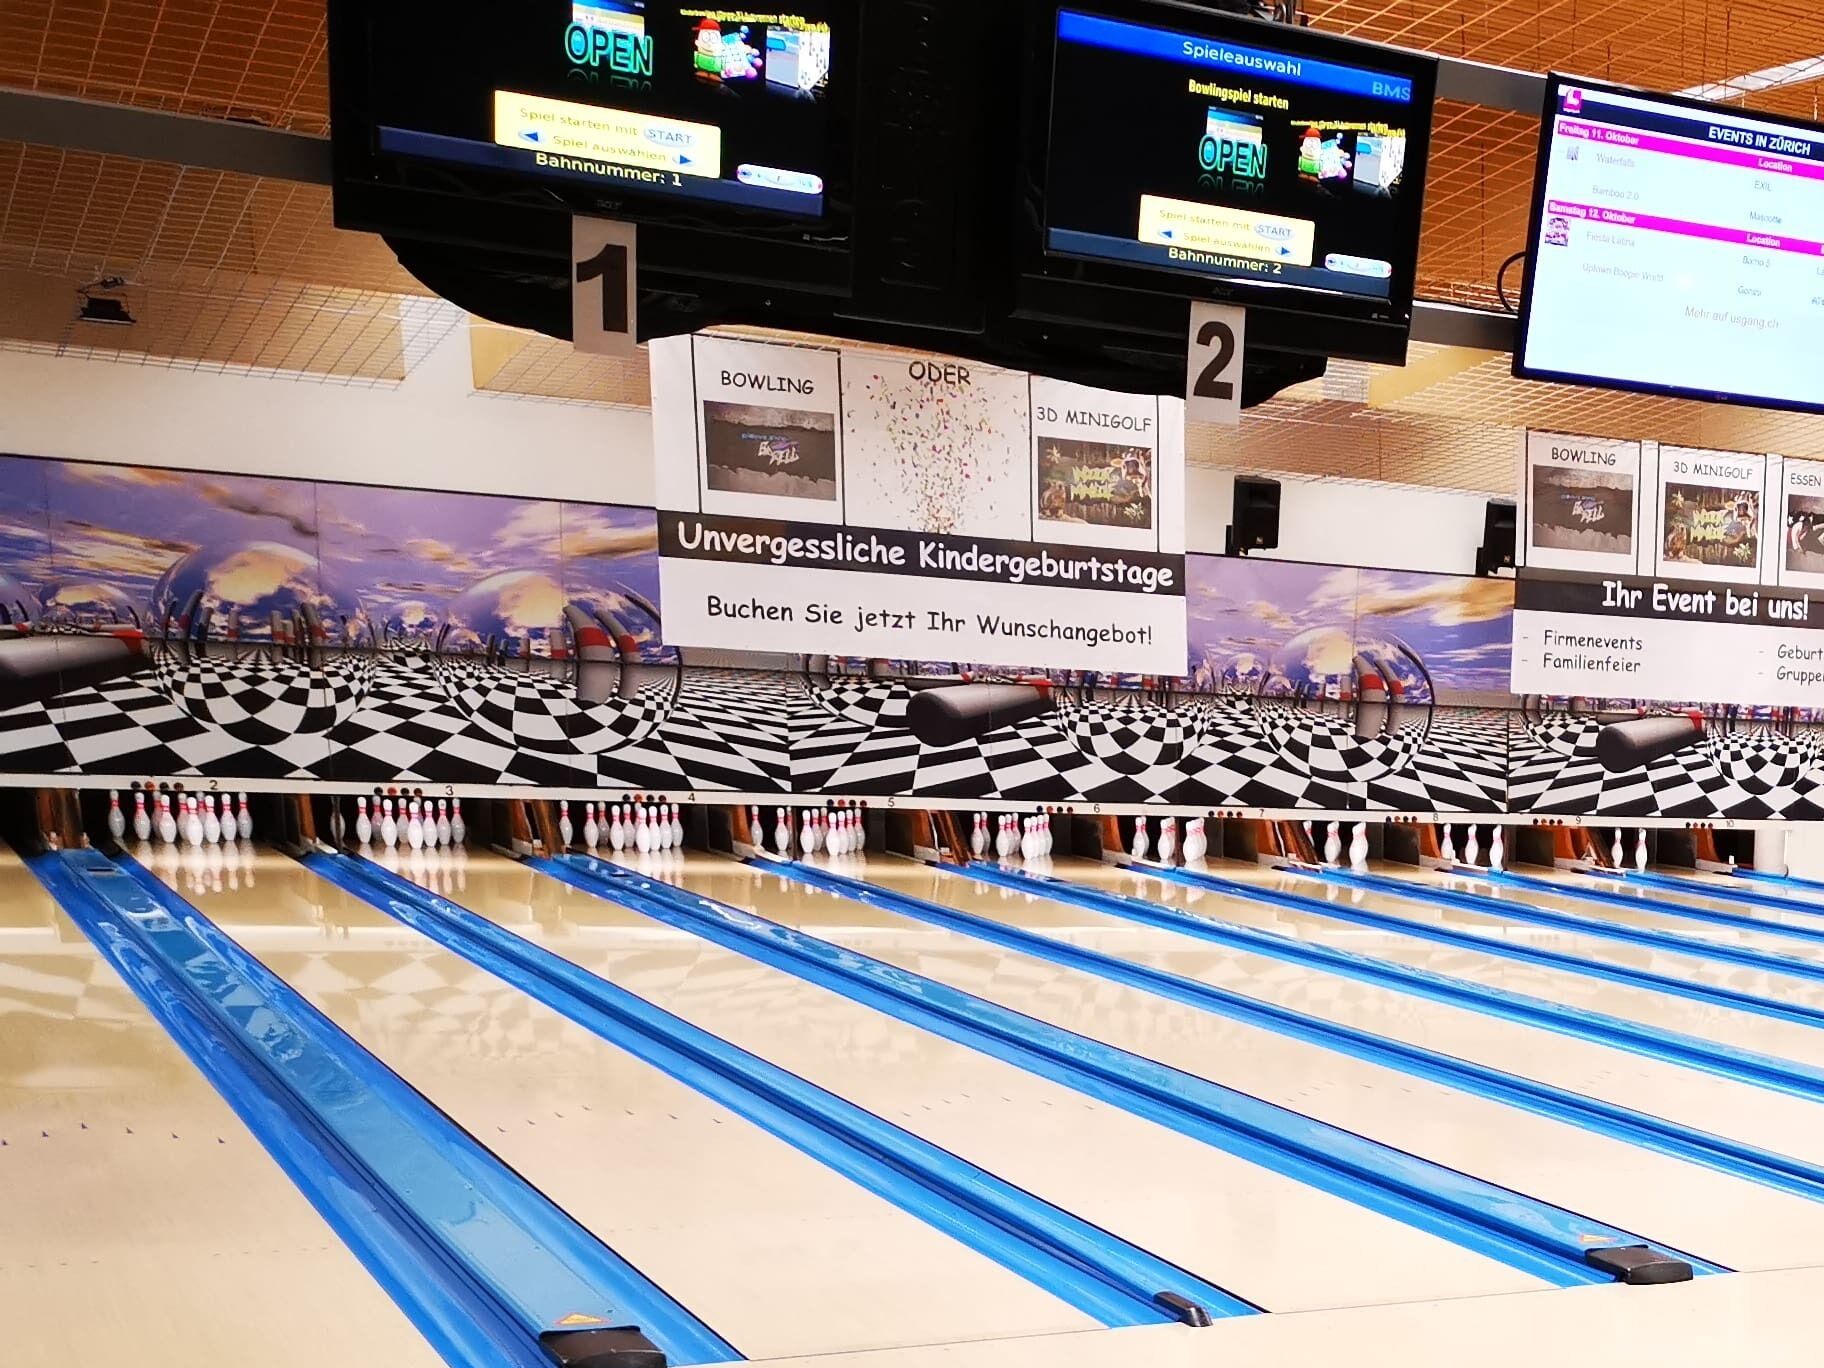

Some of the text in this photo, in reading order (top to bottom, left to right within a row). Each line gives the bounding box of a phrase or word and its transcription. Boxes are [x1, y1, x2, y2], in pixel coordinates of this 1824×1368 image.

[565, 22, 653, 75] OPEN
[1183, 40, 1301, 77] Spieleauswahl
[1188, 78, 1289, 110] Bowlingspiel starten
[1371, 81, 1411, 101] BMS
[520, 108, 692, 145] Spiel starten mit START
[553, 135, 588, 151] Spiel
[1559, 122, 1589, 138] Freitag
[1605, 131, 1640, 145] Oktober
[1758, 157, 1793, 173] Location
[1708, 126, 1811, 156] EVENTS IN ZÜRICH
[1199, 133, 1267, 179] OPEN
[536, 152, 682, 187] Bahnnummer: 1
[1258, 224, 1292, 237] START
[1602, 211, 1636, 225] Oktober
[1746, 233, 1780, 248] Location
[1168, 247, 1282, 275] Bahnnummer: 2
[576, 243, 629, 333] 1
[1193, 320, 1235, 400] 2
[720, 369, 815, 395] BOWLING
[908, 360, 971, 387] ODER
[1036, 405, 1152, 430] 3D MINIGOLF
[1551, 447, 1616, 467] BOWLING
[1673, 461, 1753, 480] 3D MINIGOLF
[1790, 472, 1821, 488] ESSEN
[677, 520, 1174, 594] Unvergessliche Kindergeburtstage
[1602, 580, 1809, 620] Ihr Event bei uns!
[706, 595, 1153, 648] Buchen Sie jetzt Ihr Wunschangebot!
[1544, 629, 1643, 652] Firmenevents
[1543, 654, 1641, 674] Familienfeier
[209, 779, 218, 791] 2
[445, 785, 454, 796] 3
[688, 793, 695, 802] 4
[887, 797, 894, 807] 5
[1093, 803, 1100, 813] 6
[1259, 809, 1265, 818] 7
